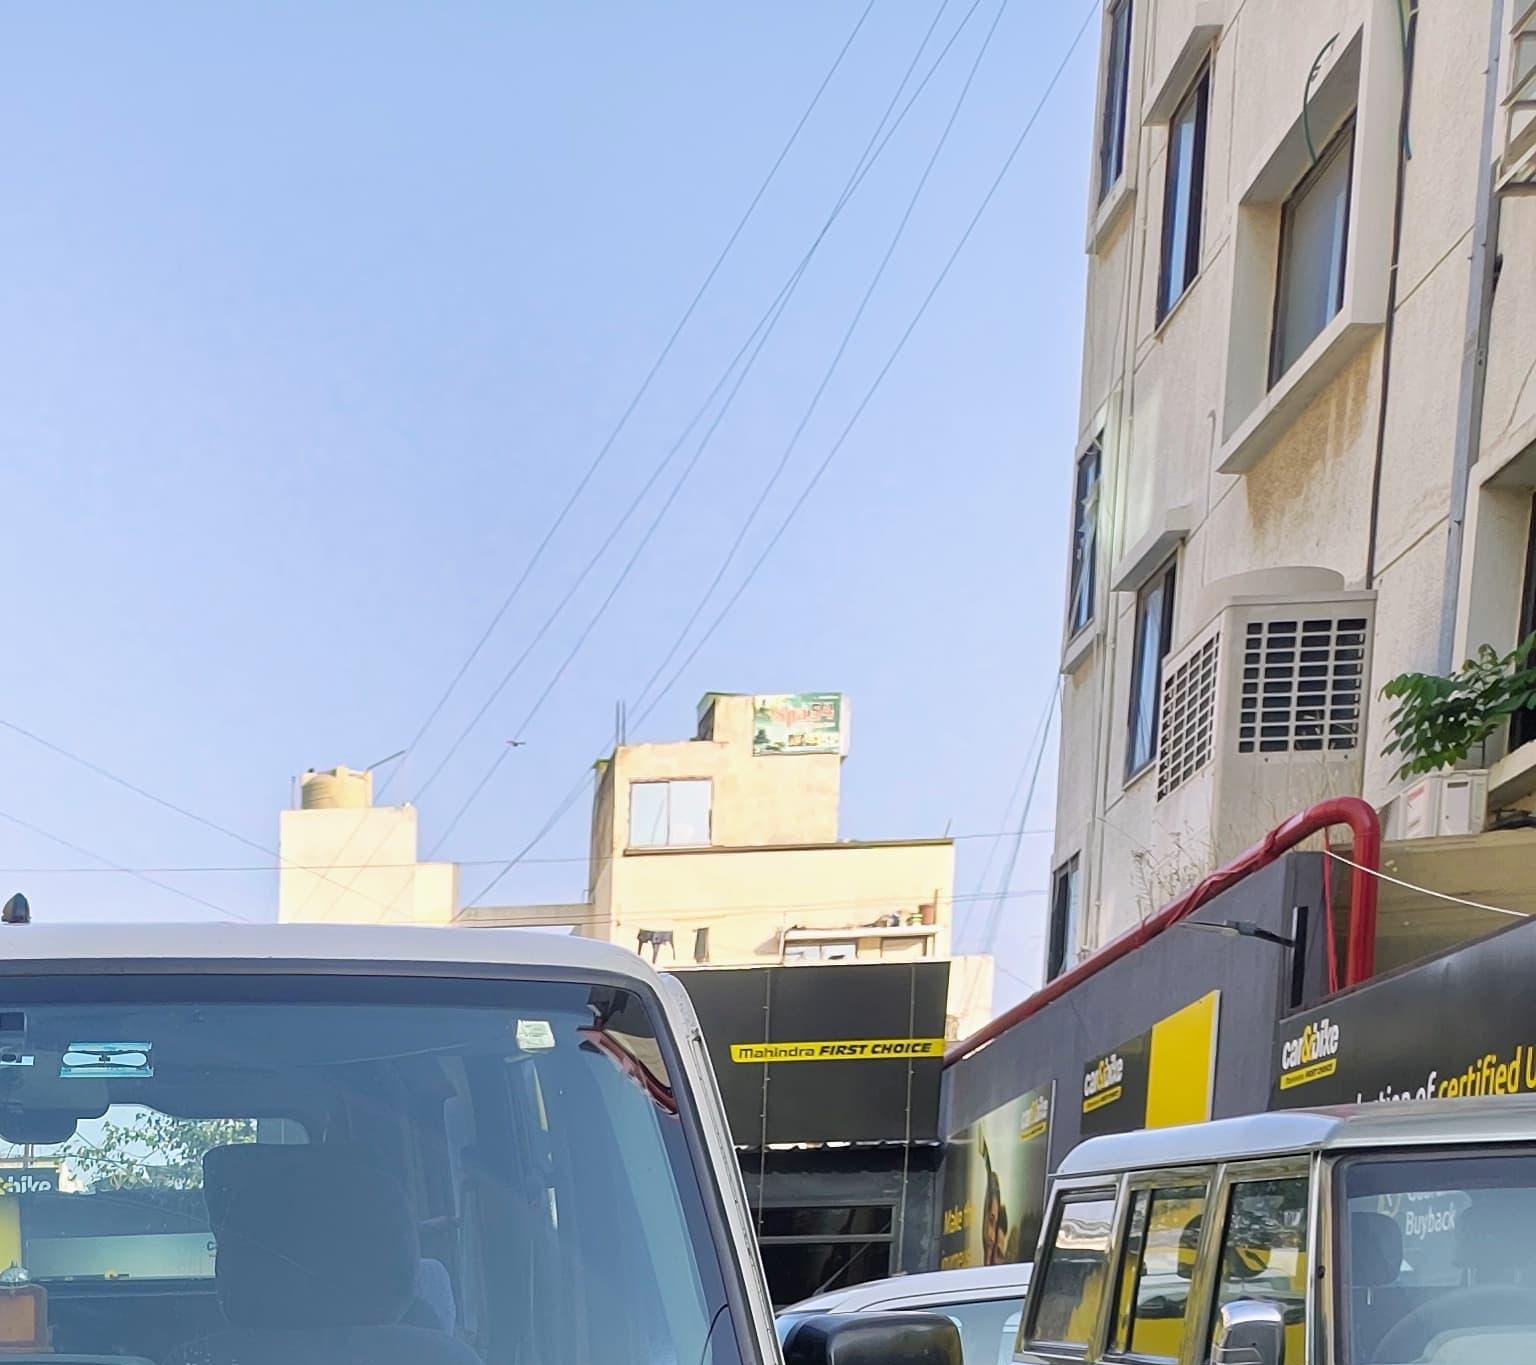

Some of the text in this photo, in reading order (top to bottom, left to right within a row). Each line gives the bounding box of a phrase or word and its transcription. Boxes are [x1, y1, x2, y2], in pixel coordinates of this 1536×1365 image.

[739, 1042, 932, 1059] Mahindra FIRST CHOICE
[1282, 1018, 1339, 1069] car&bike
[1438, 1046, 1522, 1098] certified
[1406, 1202, 1456, 1240] Buyback
